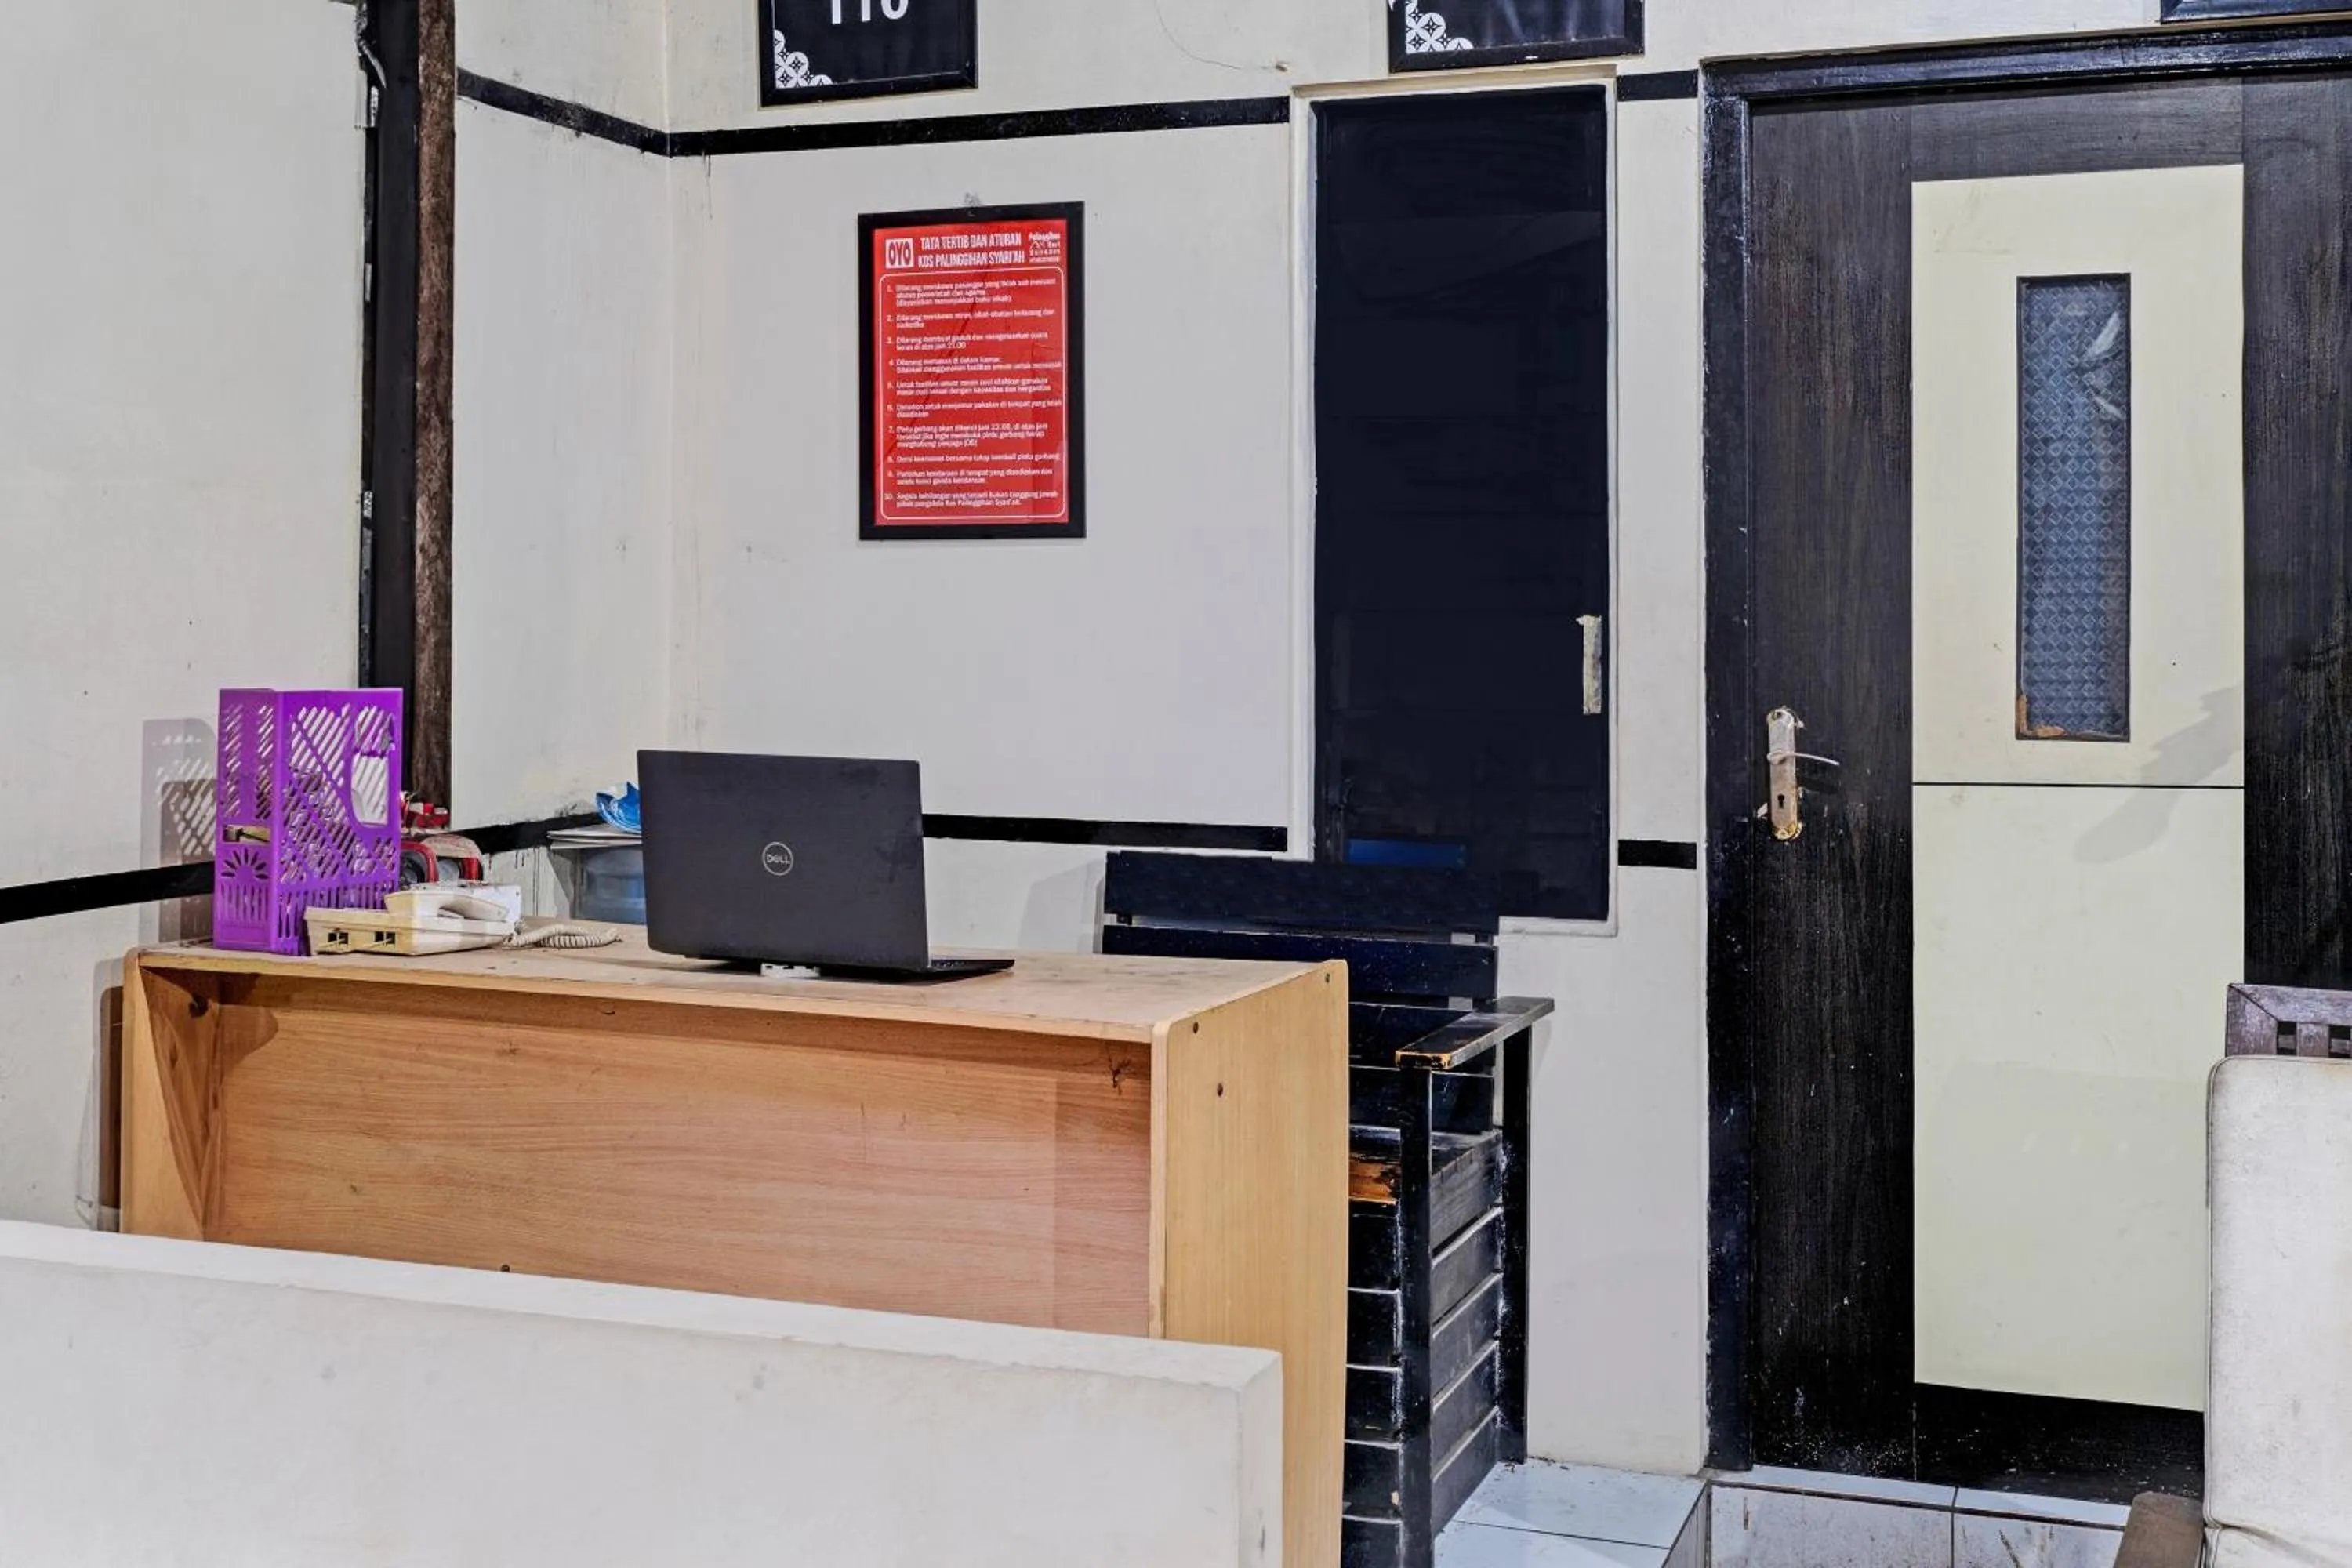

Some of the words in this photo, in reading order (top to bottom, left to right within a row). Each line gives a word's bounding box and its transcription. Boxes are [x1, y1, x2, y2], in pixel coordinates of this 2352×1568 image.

[920, 237, 940, 250] TATA
[941, 235, 969, 249] TERTIB
[970, 234, 987, 248] DAN
[989, 232, 1022, 247] ATURAN
[887, 240, 911, 267] OYO
[918, 254, 934, 268] KOS
[766, 853, 790, 864] DELL
